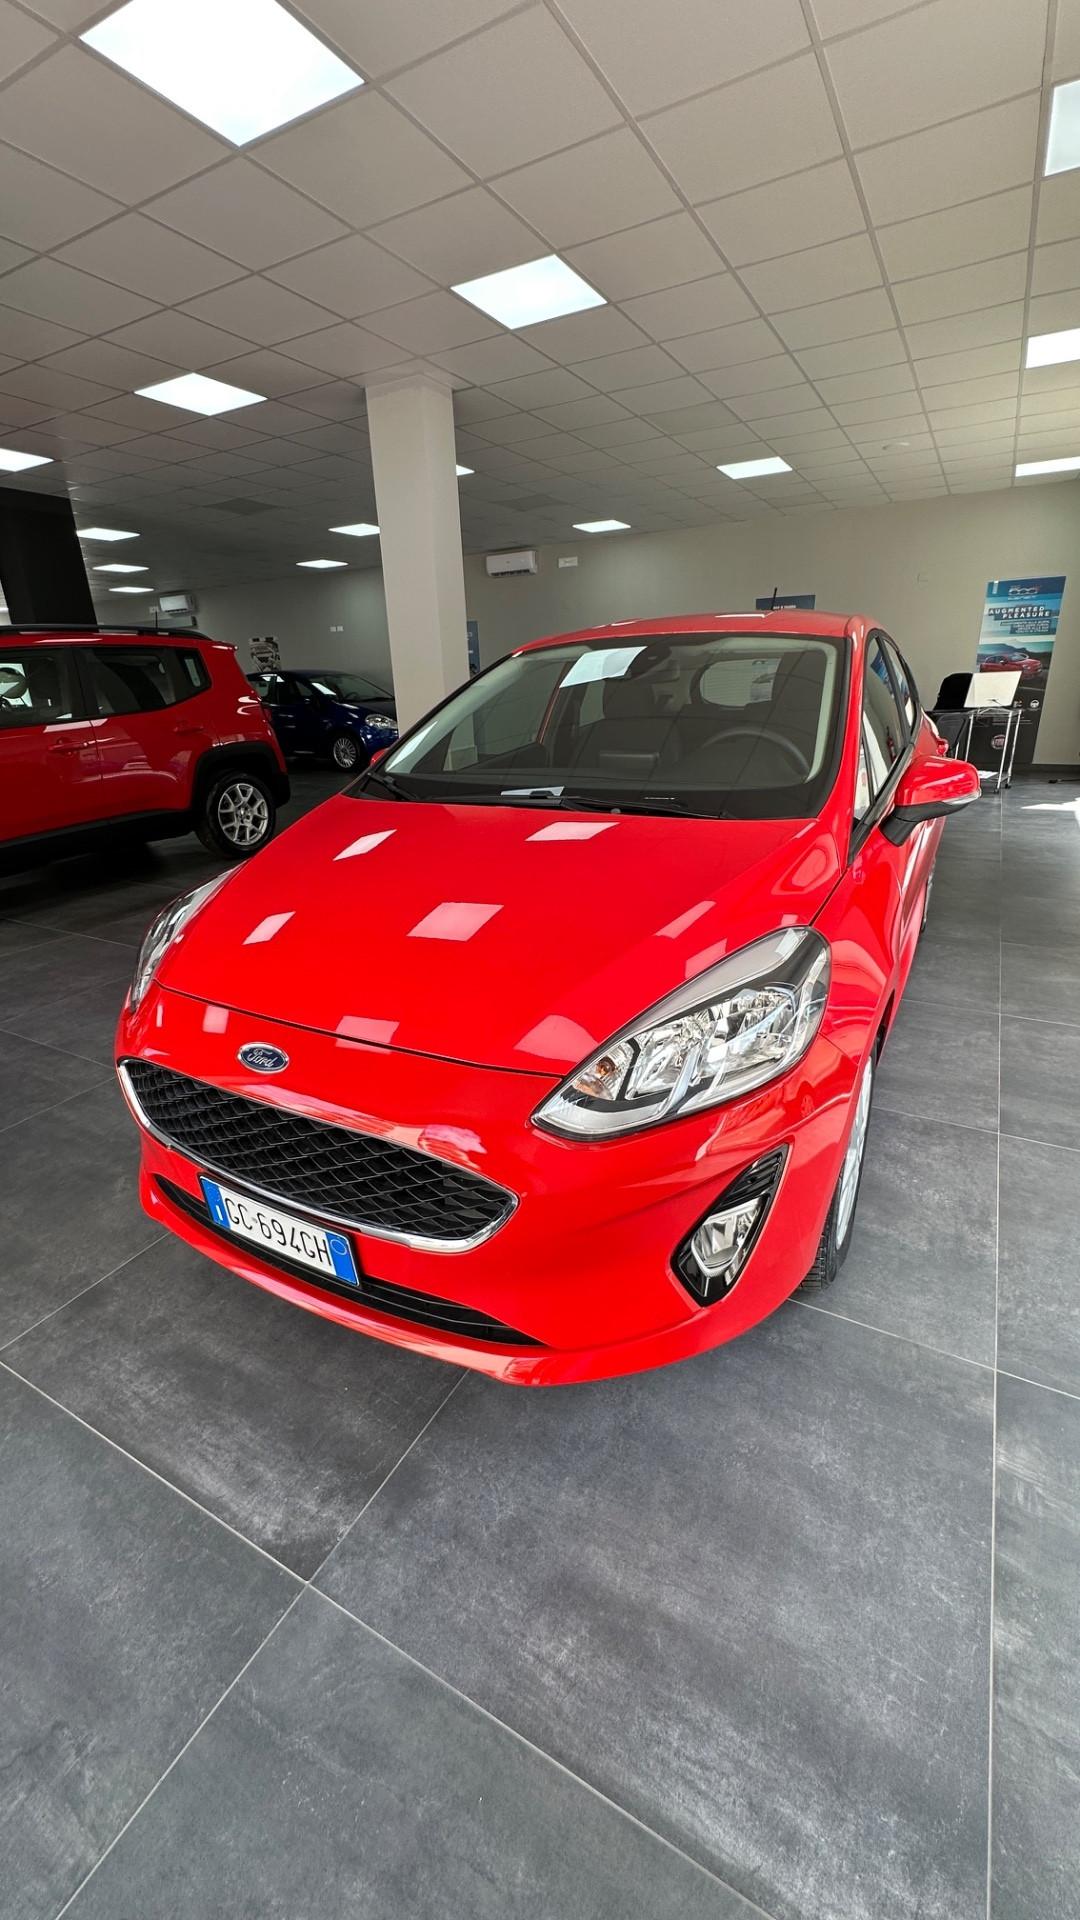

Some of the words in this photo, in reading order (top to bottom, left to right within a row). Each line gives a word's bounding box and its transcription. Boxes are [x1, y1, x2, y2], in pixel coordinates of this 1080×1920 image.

[989, 606, 1045, 615] AUGMENTED
[1002, 611, 1050, 619] PLEASURE
[246, 1048, 279, 1067] Ford
